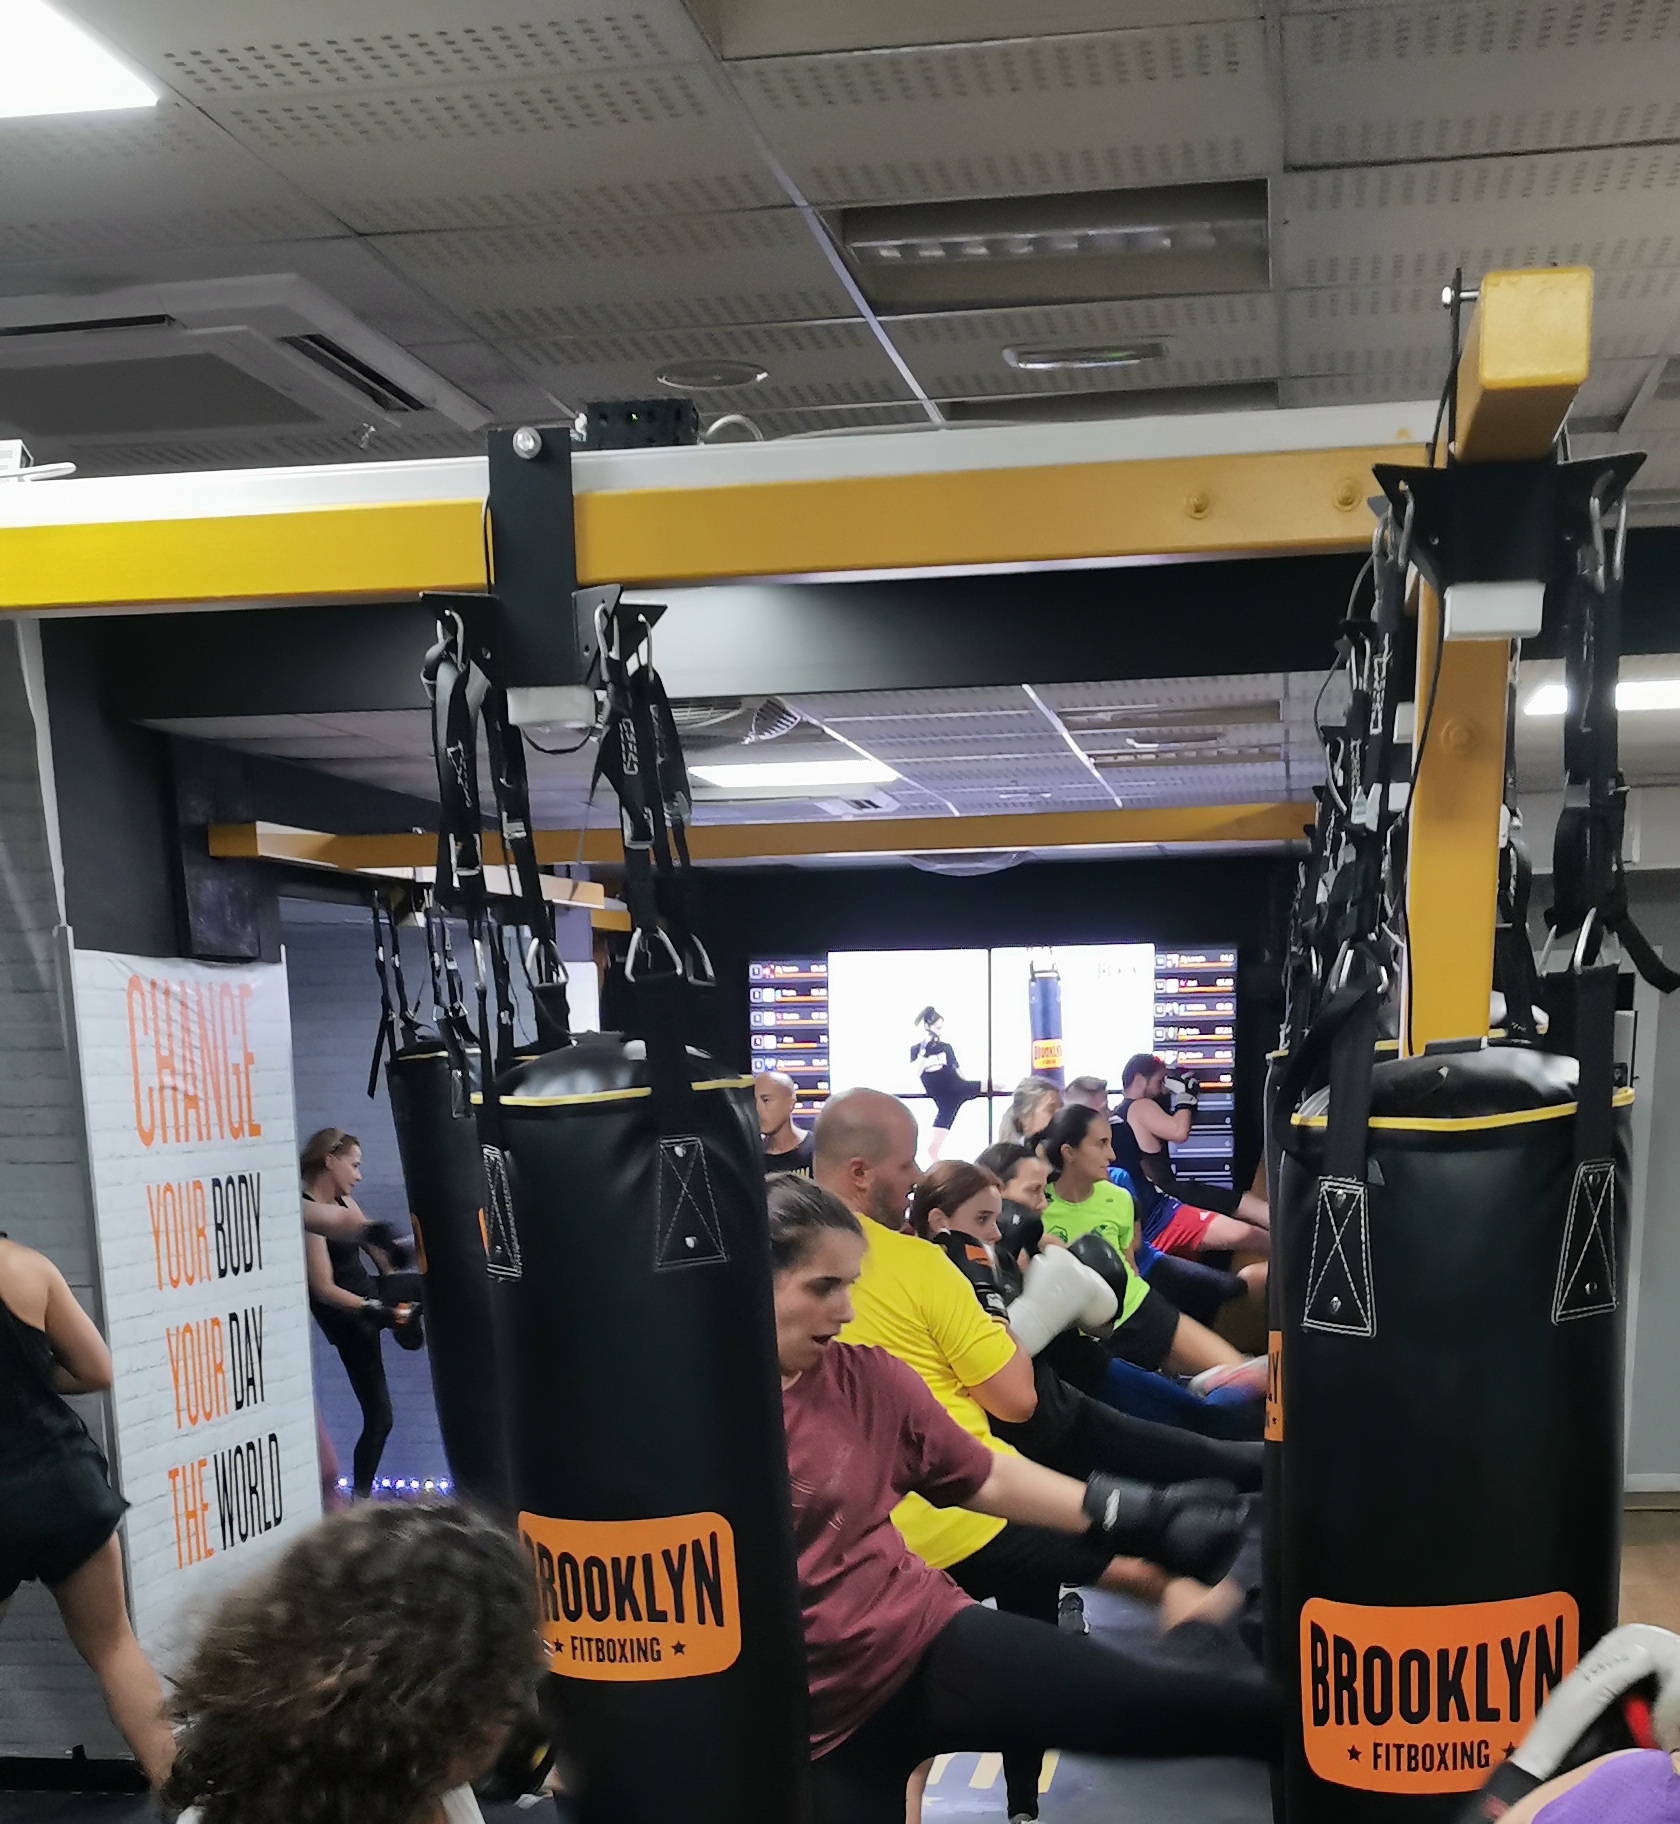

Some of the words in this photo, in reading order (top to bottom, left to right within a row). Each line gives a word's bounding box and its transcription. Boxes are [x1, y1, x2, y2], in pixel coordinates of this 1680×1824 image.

[126, 974, 261, 1147] CHANGE
[146, 1180, 211, 1291] YOUR
[211, 1172, 262, 1279] BODY
[166, 1316, 228, 1429] YOUR
[229, 1305, 264, 1411] DAY
[168, 1458, 214, 1570] THE
[214, 1432, 282, 1551] WORLD
[570, 1635, 662, 1663] FITBOXING
[1310, 1615, 1564, 1727] BROOKLYN
[1372, 1739, 1490, 1772] FITBOXING
